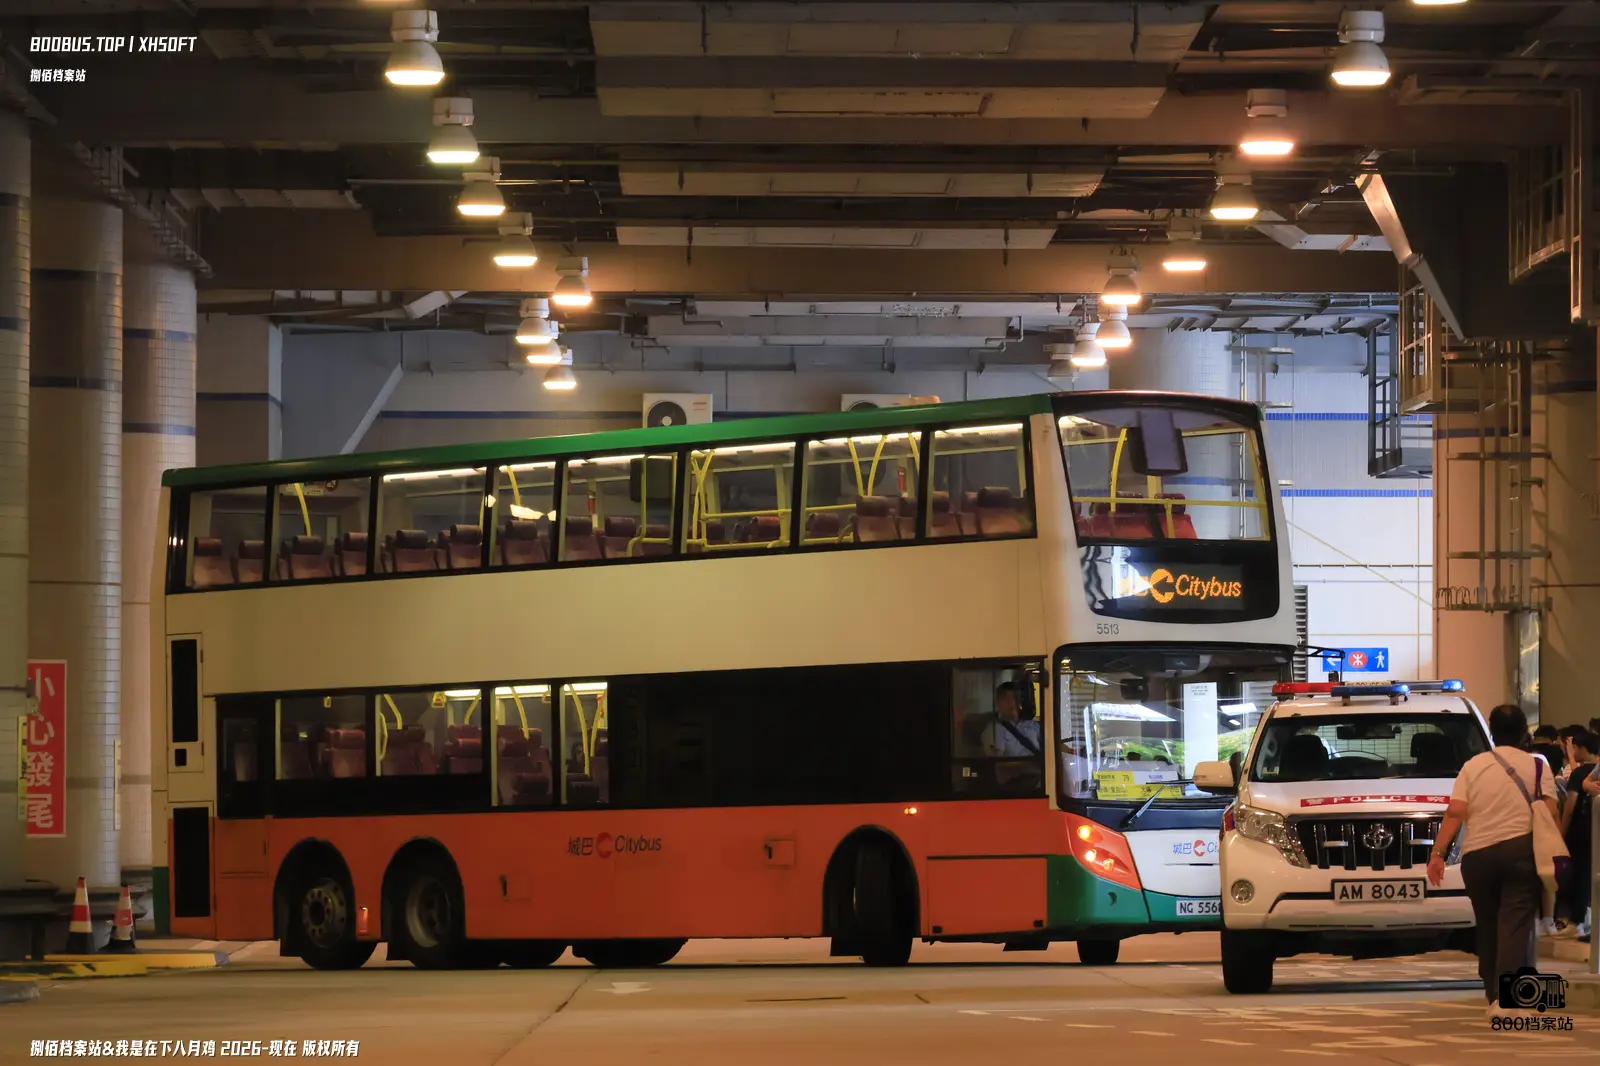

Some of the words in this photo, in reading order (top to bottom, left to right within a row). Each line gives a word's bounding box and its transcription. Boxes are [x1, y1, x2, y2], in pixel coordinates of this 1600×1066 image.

[1175, 574, 1242, 600] Citybus
[1097, 623, 1120, 635] 5513
[1333, 795, 1417, 803] POLICE
[568, 836, 594, 856] 城巴
[614, 834, 662, 854] Citybus
[1339, 885, 1363, 899] AM
[1371, 883, 1421, 899] 8043
[1179, 902, 1194, 914] NG
